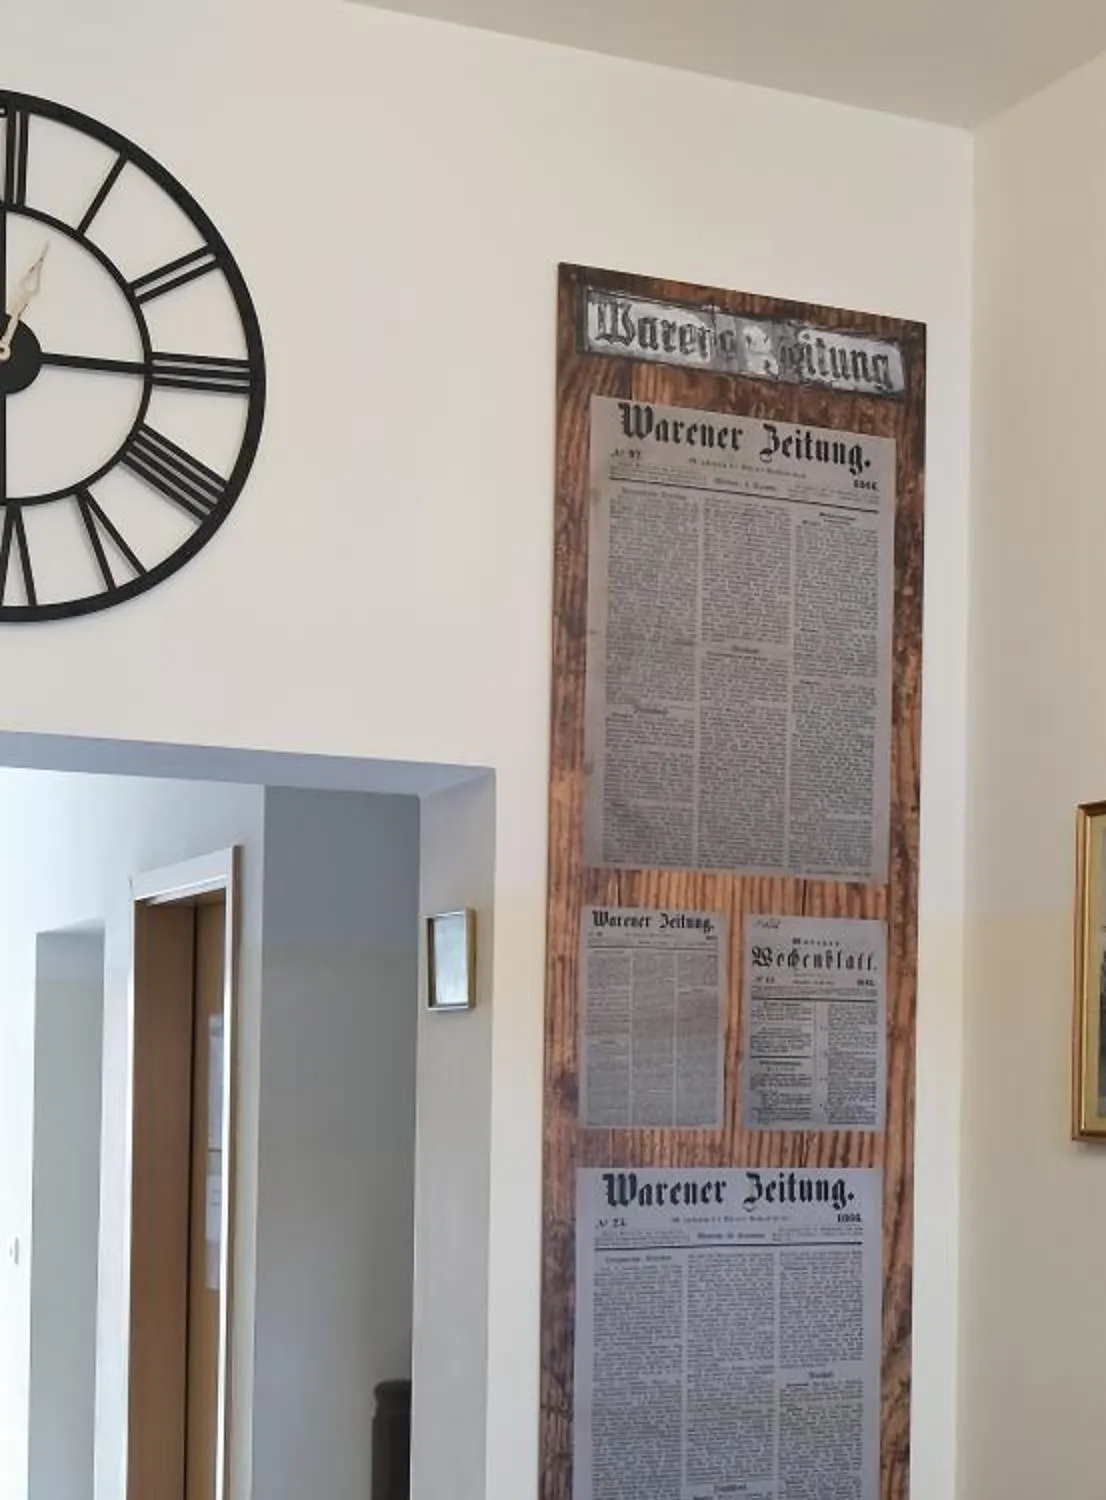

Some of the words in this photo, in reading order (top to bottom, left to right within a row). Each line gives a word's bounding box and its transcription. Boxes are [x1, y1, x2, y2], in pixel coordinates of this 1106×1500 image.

[617, 401, 744, 452] Warener
[592, 909, 651, 929] Warener
[602, 1171, 727, 1207] Warener
[742, 1171, 855, 1213] Zeitung.
